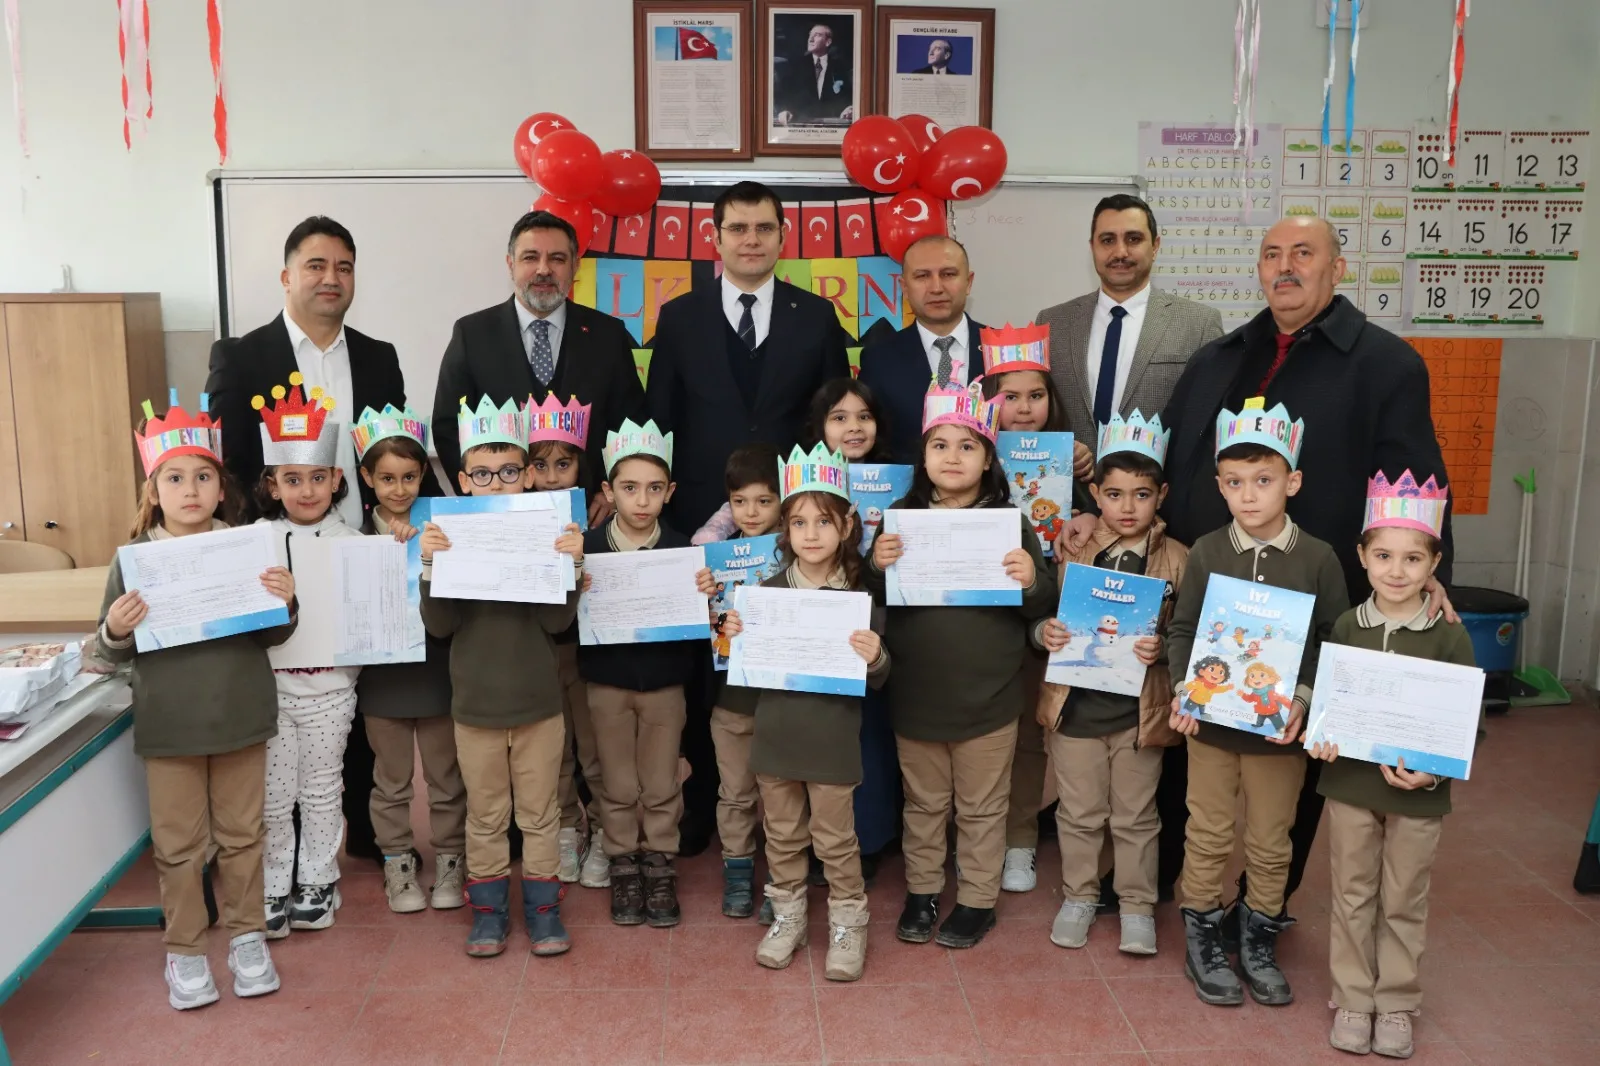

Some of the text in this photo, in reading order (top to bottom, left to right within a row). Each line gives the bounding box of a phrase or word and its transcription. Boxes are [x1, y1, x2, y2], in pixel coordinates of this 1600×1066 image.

[1175, 132, 1198, 142] HARF
[1147, 157, 1156, 168] A
[1162, 157, 1169, 168] B
[1175, 157, 1184, 168] C
[1206, 157, 1215, 168] D
[1221, 157, 1227, 168] E
[1233, 157, 1240, 168] F
[1260, 156, 1271, 169] Ğ
[1299, 162, 1305, 180] 1
[1416, 157, 1438, 179] 10
[1474, 154, 1489, 176] 11
[1516, 154, 1539, 177] 12
[1557, 154, 1578, 176] 13
[1339, 163, 1352, 180] 2
[1384, 163, 1394, 181] 3
[1148, 177, 1156, 187] H
[1176, 177, 1184, 188] J
[1188, 177, 1196, 188] K
[1200, 177, 1207, 188] L
[1213, 177, 1224, 188] M
[1230, 177, 1240, 188] N
[1260, 175, 1271, 189] Ö
[1159, 196, 1165, 208] R
[1170, 196, 1177, 208] S
[1193, 196, 1201, 208] T
[1206, 197, 1215, 208] U
[1221, 194, 1230, 208] Ü
[1262, 197, 1271, 208] Z
[966, 209, 1025, 225] 3 hece
[1161, 224, 1167, 236] b
[1204, 223, 1210, 236] d
[1233, 224, 1238, 236] f
[1246, 229, 1252, 241] g
[1338, 228, 1348, 246] 5
[1381, 229, 1391, 246] 6
[1419, 221, 1442, 243] 14
[1464, 221, 1485, 244] 15
[1508, 222, 1528, 244] 16
[1551, 223, 1572, 244] 17
[1192, 244, 1198, 254] k
[1196, 265, 1200, 273] t
[1248, 266, 1254, 278] y
[1184, 289, 1191, 300] 4
[1197, 289, 1204, 300] 5
[1209, 289, 1216, 300] 6
[1221, 289, 1228, 300] 7
[1233, 289, 1239, 300] 8
[1245, 289, 1251, 300] 9
[1378, 293, 1388, 310] 9
[1426, 287, 1446, 308] 18
[1470, 287, 1491, 308] 19
[1508, 288, 1540, 310] 20
[1020, 437, 1038, 450] İYİ
[1009, 449, 1050, 461] TATİLLER
[862, 469, 879, 482] İYİ
[852, 480, 892, 492] TATİLLER
[733, 542, 751, 557] İYİ
[1103, 576, 1124, 591] İYİ
[1091, 588, 1136, 604] TATİLLER
